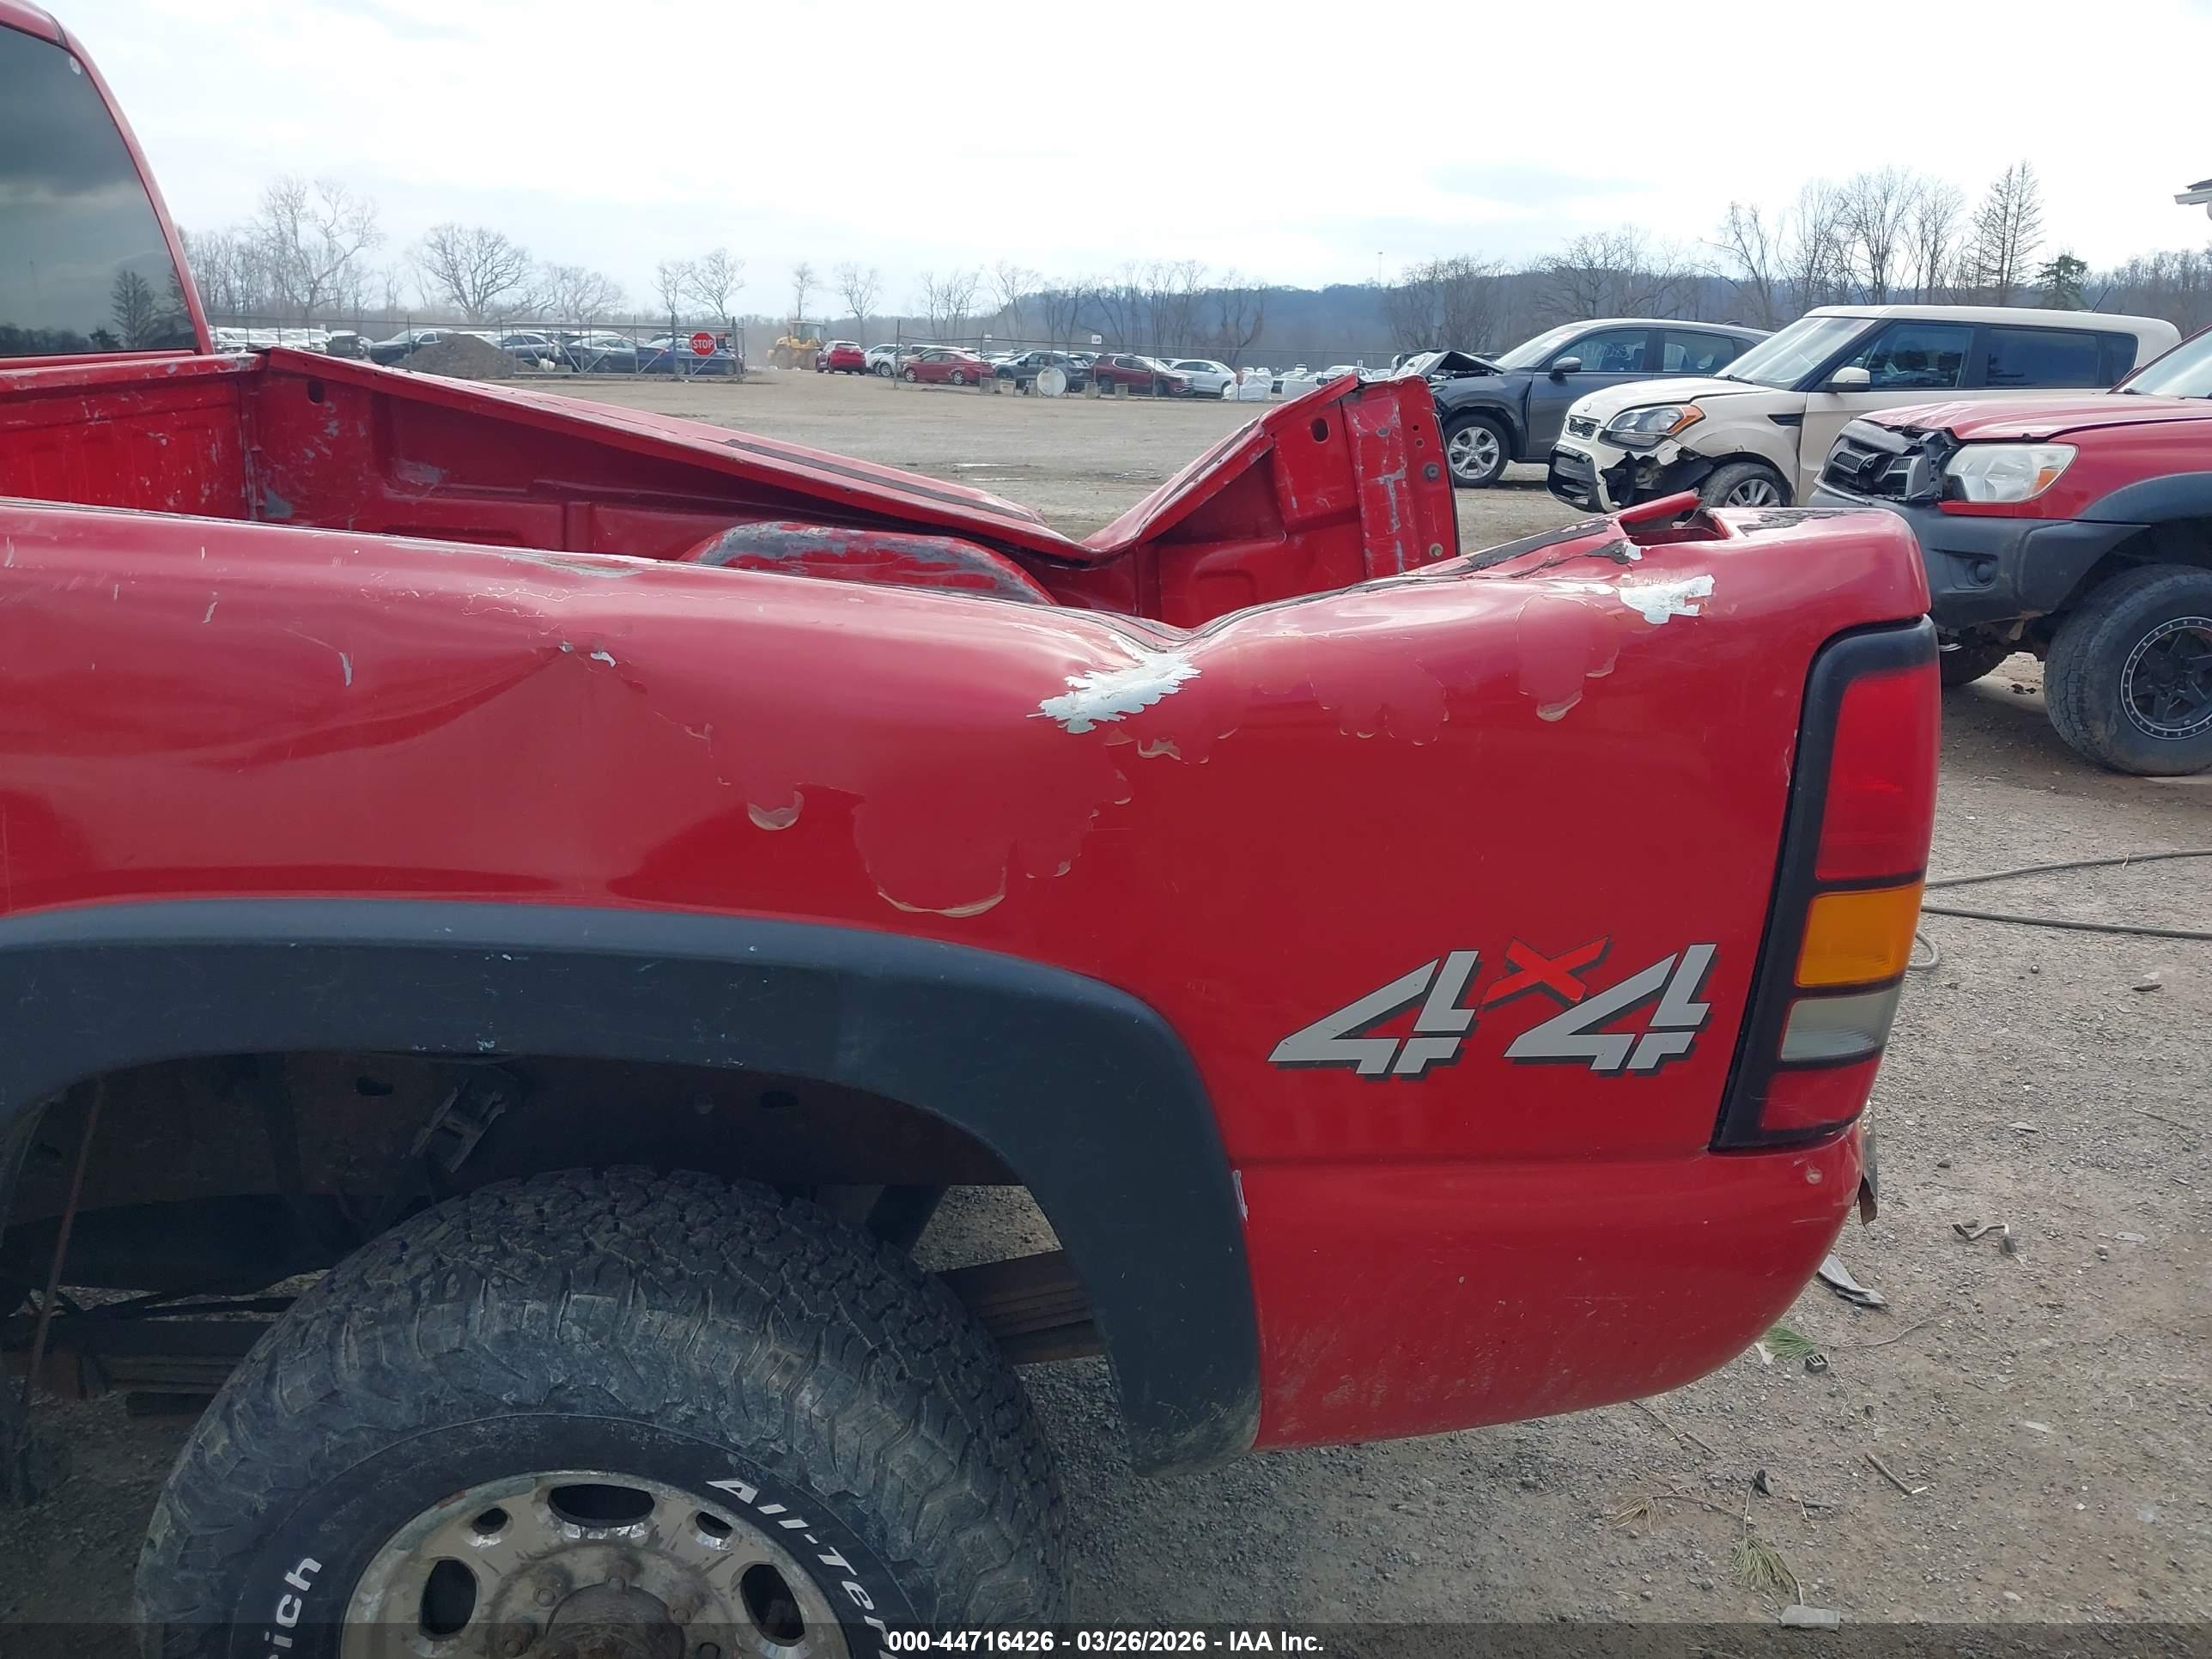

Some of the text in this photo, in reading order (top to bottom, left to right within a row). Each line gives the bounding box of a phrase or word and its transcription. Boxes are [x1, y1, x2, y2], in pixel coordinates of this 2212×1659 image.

[692, 339, 714, 349] STOP
[264, 1558, 323, 1659] ich
[705, 1478, 899, 1659] All-Ter
